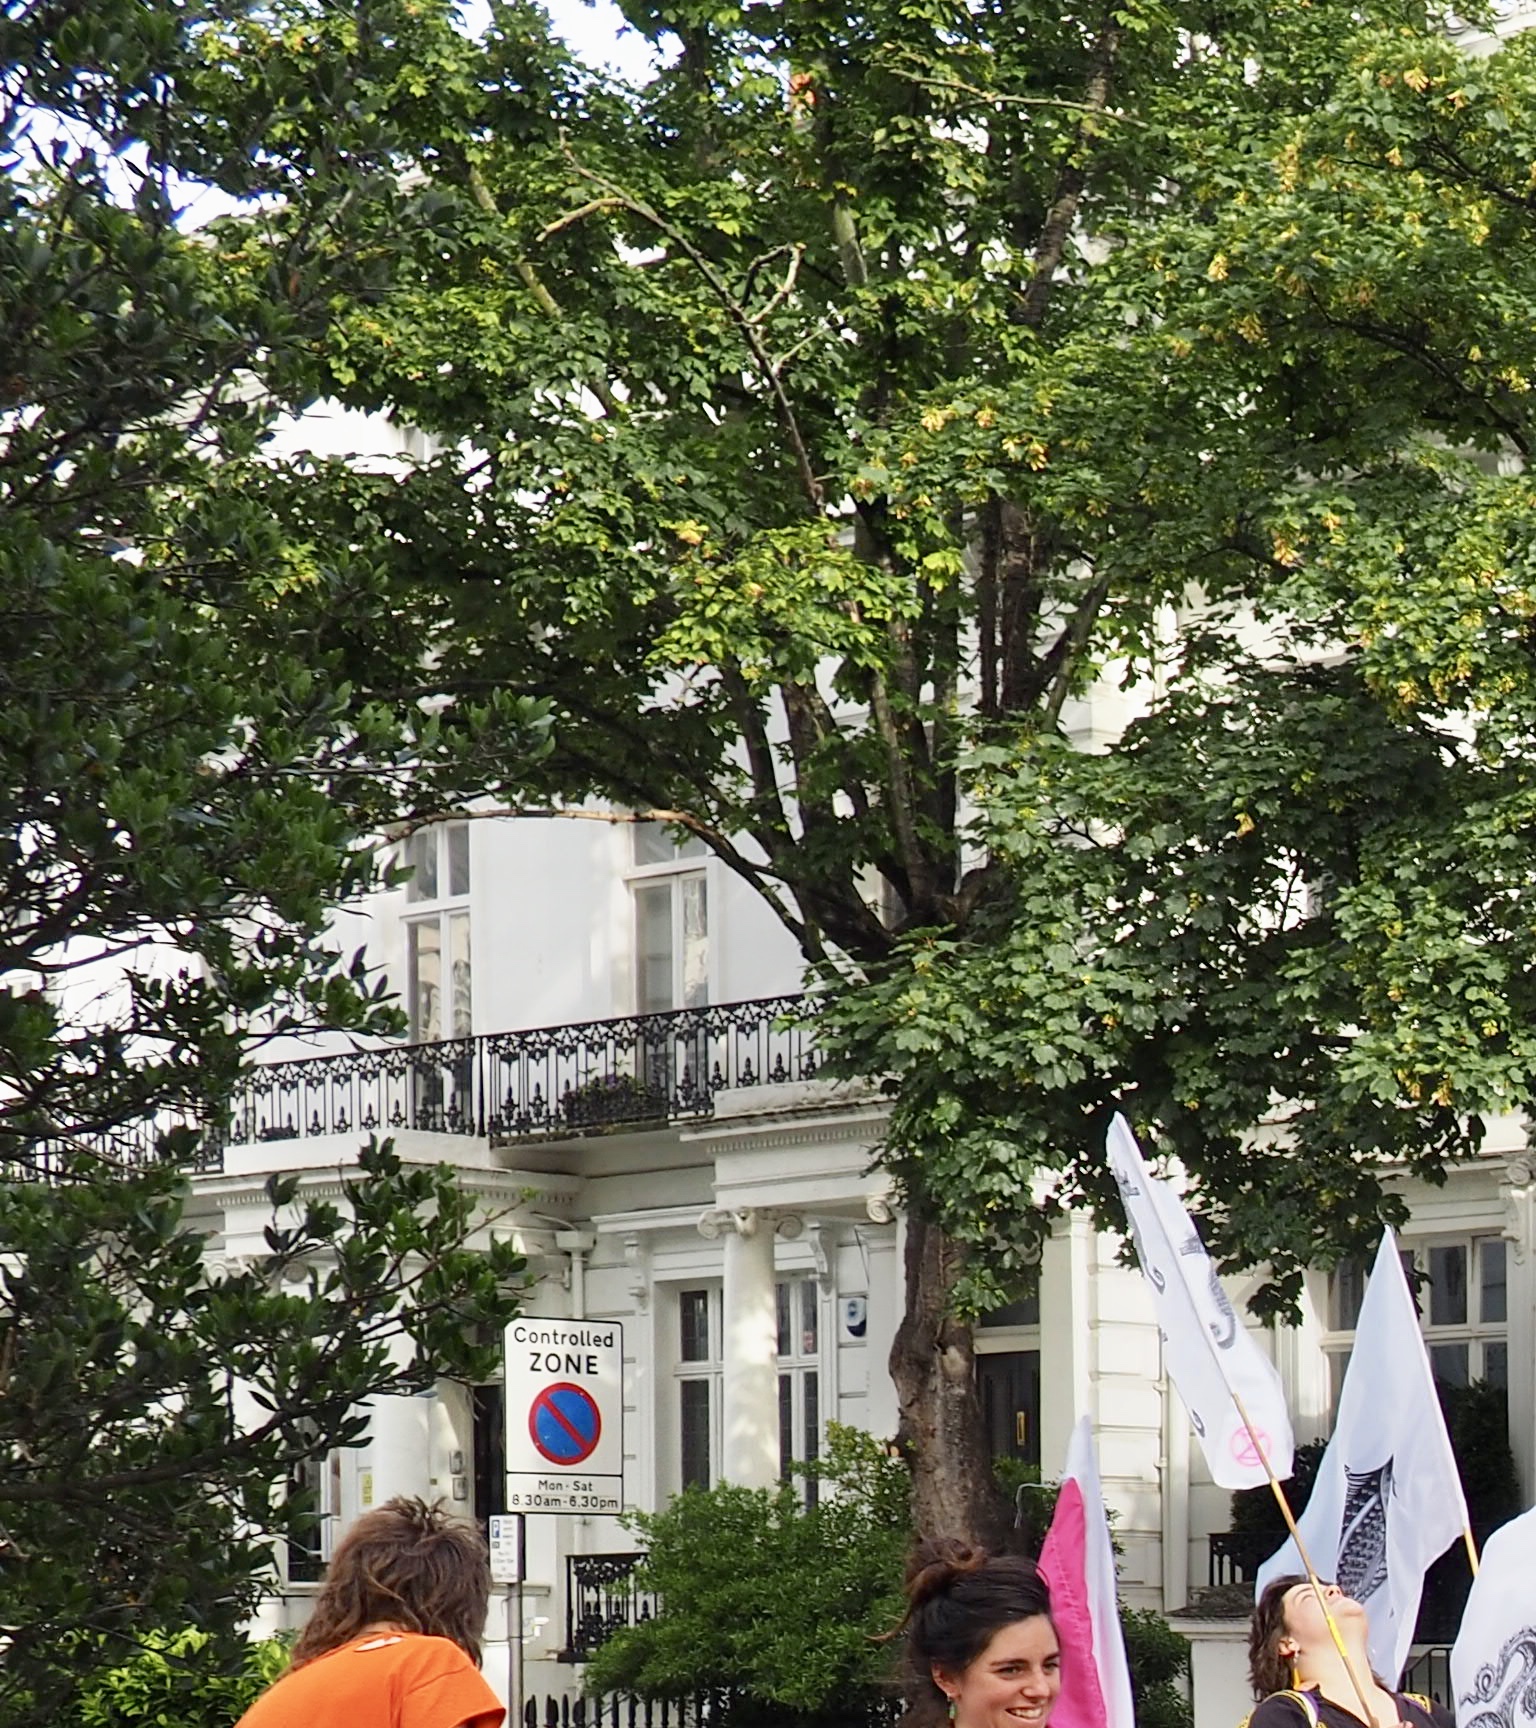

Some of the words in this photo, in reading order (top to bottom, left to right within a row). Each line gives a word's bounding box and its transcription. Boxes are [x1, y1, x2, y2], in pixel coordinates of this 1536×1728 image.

[514, 1326, 613, 1348] Controlled
[529, 1352, 599, 1375] ZONE
[538, 1480, 563, 1491] Mon
[572, 1480, 593, 1492] Sat
